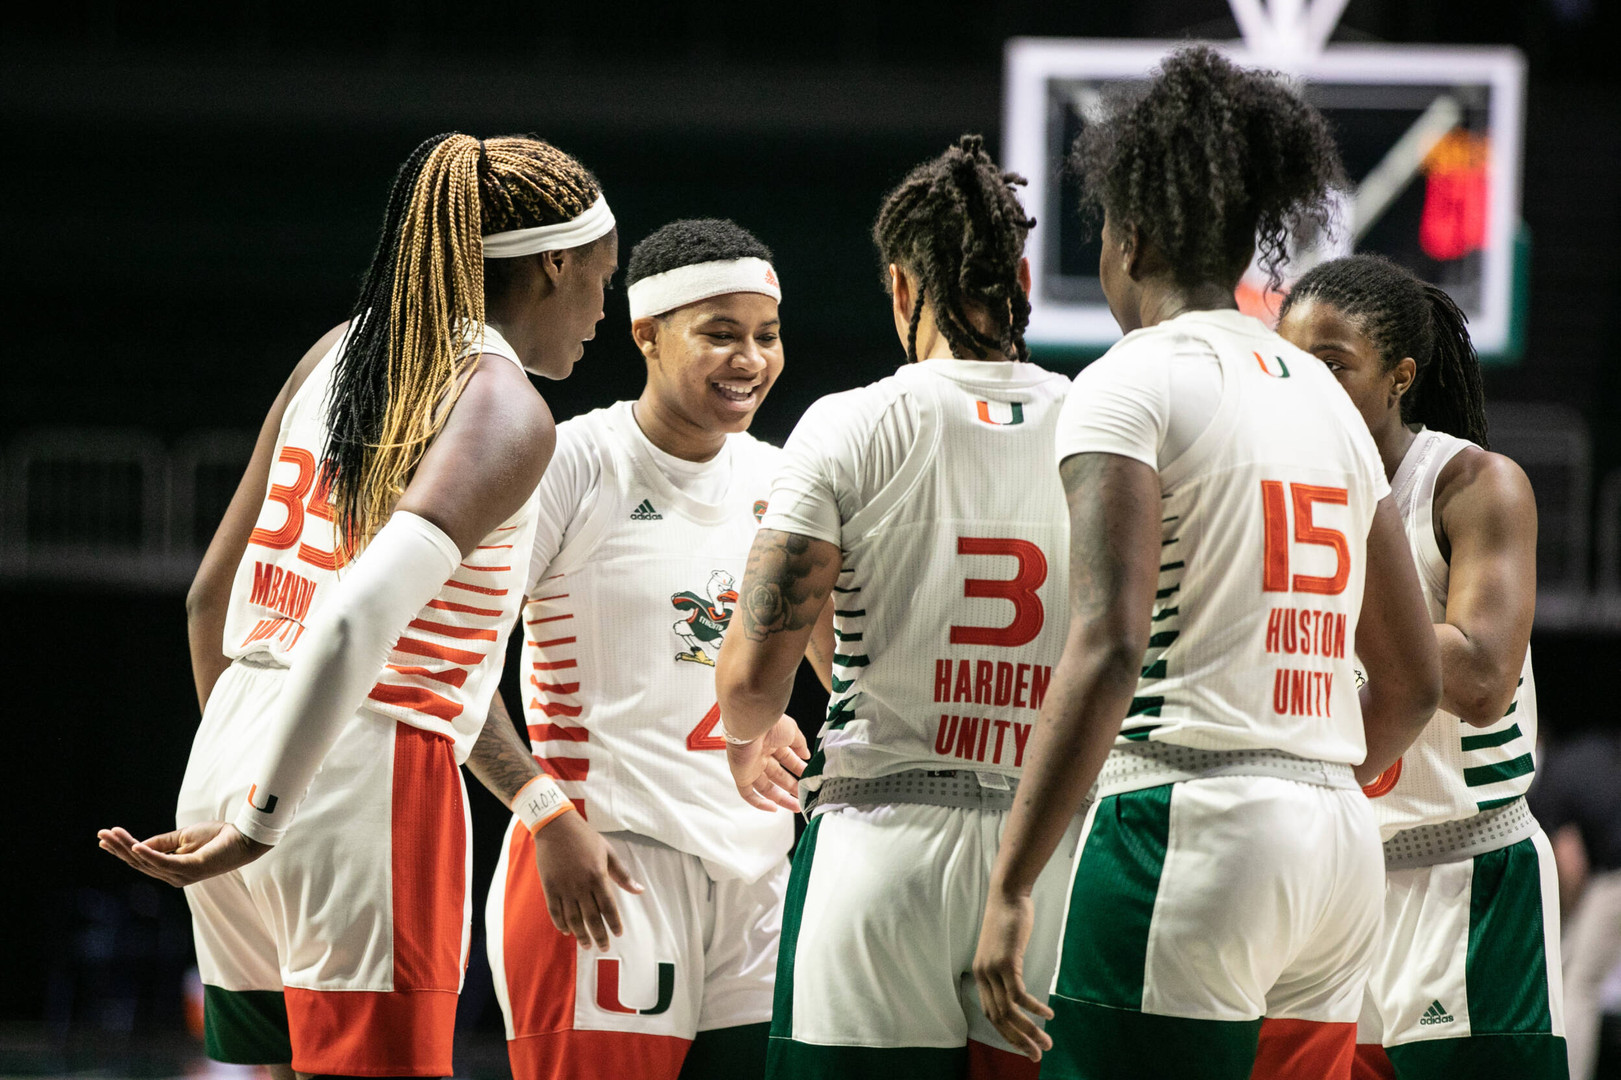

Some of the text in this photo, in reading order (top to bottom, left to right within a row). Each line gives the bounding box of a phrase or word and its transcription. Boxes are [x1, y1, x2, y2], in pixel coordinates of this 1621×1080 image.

[248, 446, 359, 571] 35
[630, 511, 663, 521] adidas
[1261, 480, 1351, 595] 15
[950, 537, 1047, 647] 3
[1266, 608, 1346, 659] HUSTON
[934, 659, 1051, 710] HARDEN
[1273, 668, 1333, 718] UNITY
[935, 714, 1032, 768] UNITY
[1420, 1015, 1455, 1025] adidas
